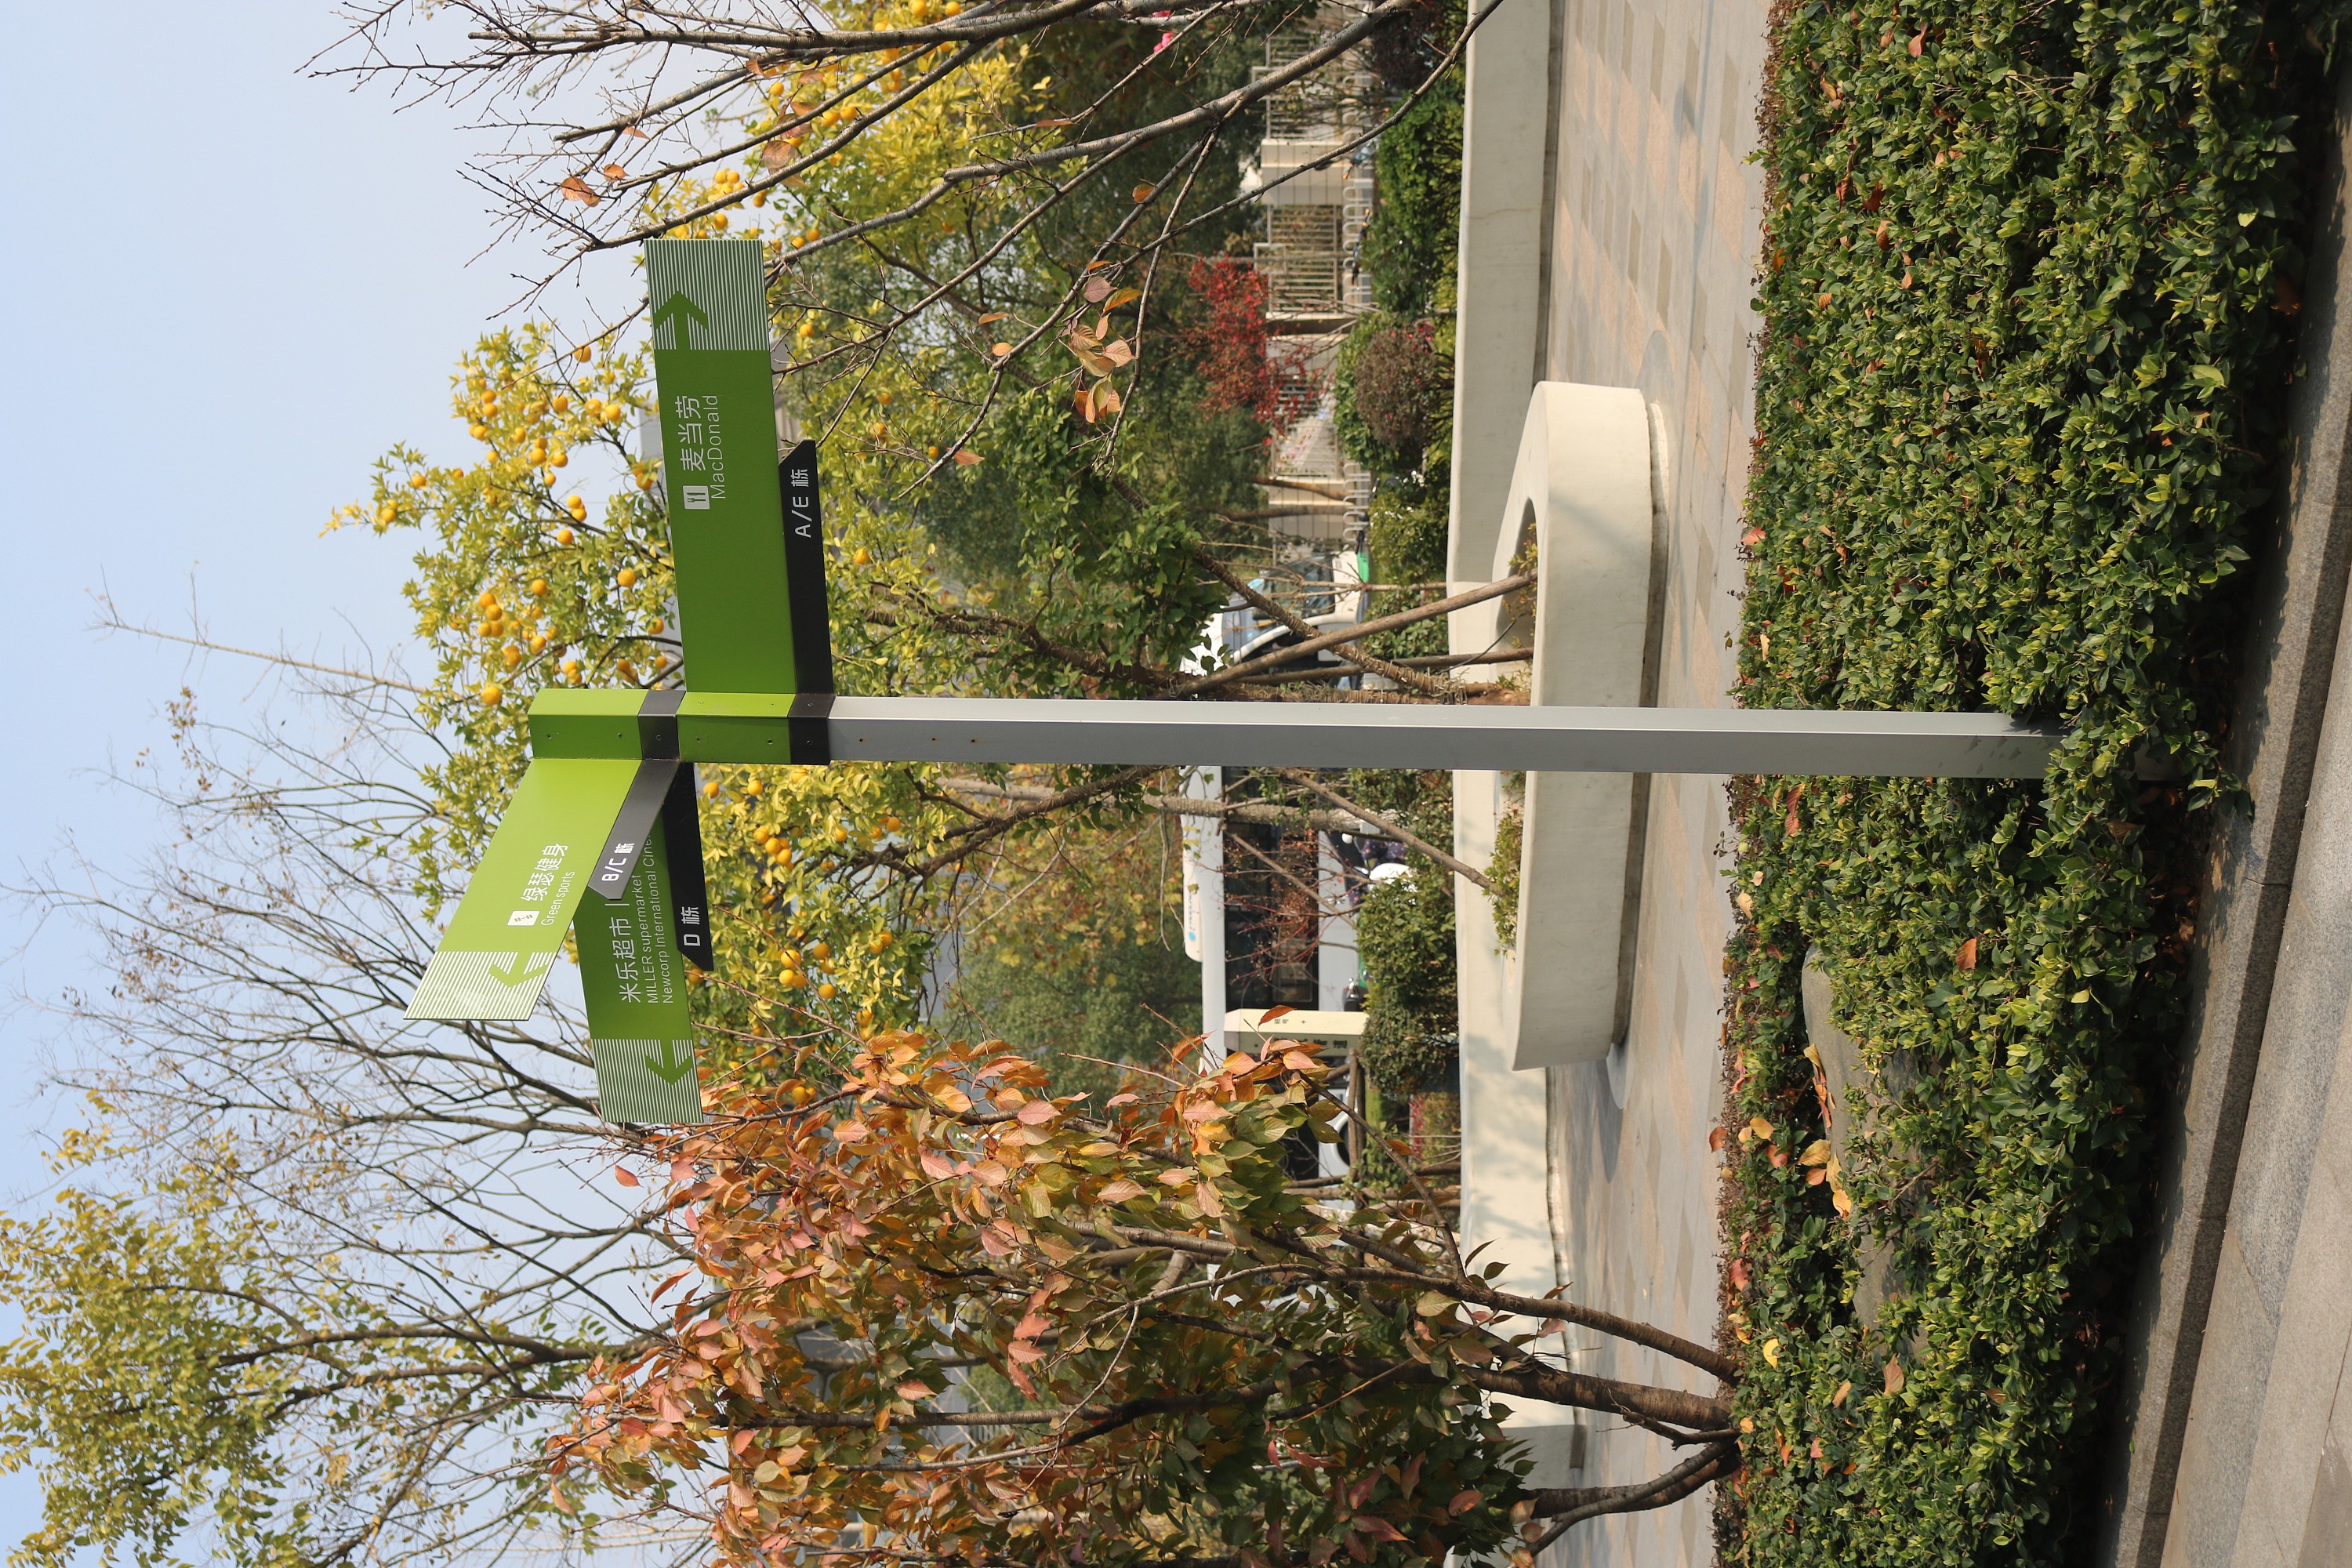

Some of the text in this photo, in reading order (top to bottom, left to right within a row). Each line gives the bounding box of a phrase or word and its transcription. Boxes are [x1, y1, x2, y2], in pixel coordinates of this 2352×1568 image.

[675, 395, 705, 471] 麦当劳
[702, 395, 726, 499] MacDonald
[791, 469, 812, 538] A/E 栋
[521, 844, 568, 902] 绿瑟健身
[601, 844, 634, 881] B/C 栋
[541, 872, 575, 926] Green sports
[643, 836, 673, 1004] Newcorp International Cine
[681, 906, 700, 946] D 栋
[609, 917, 641, 1003] 米乐超市
[631, 875, 658, 1004] MILLER supermarket
